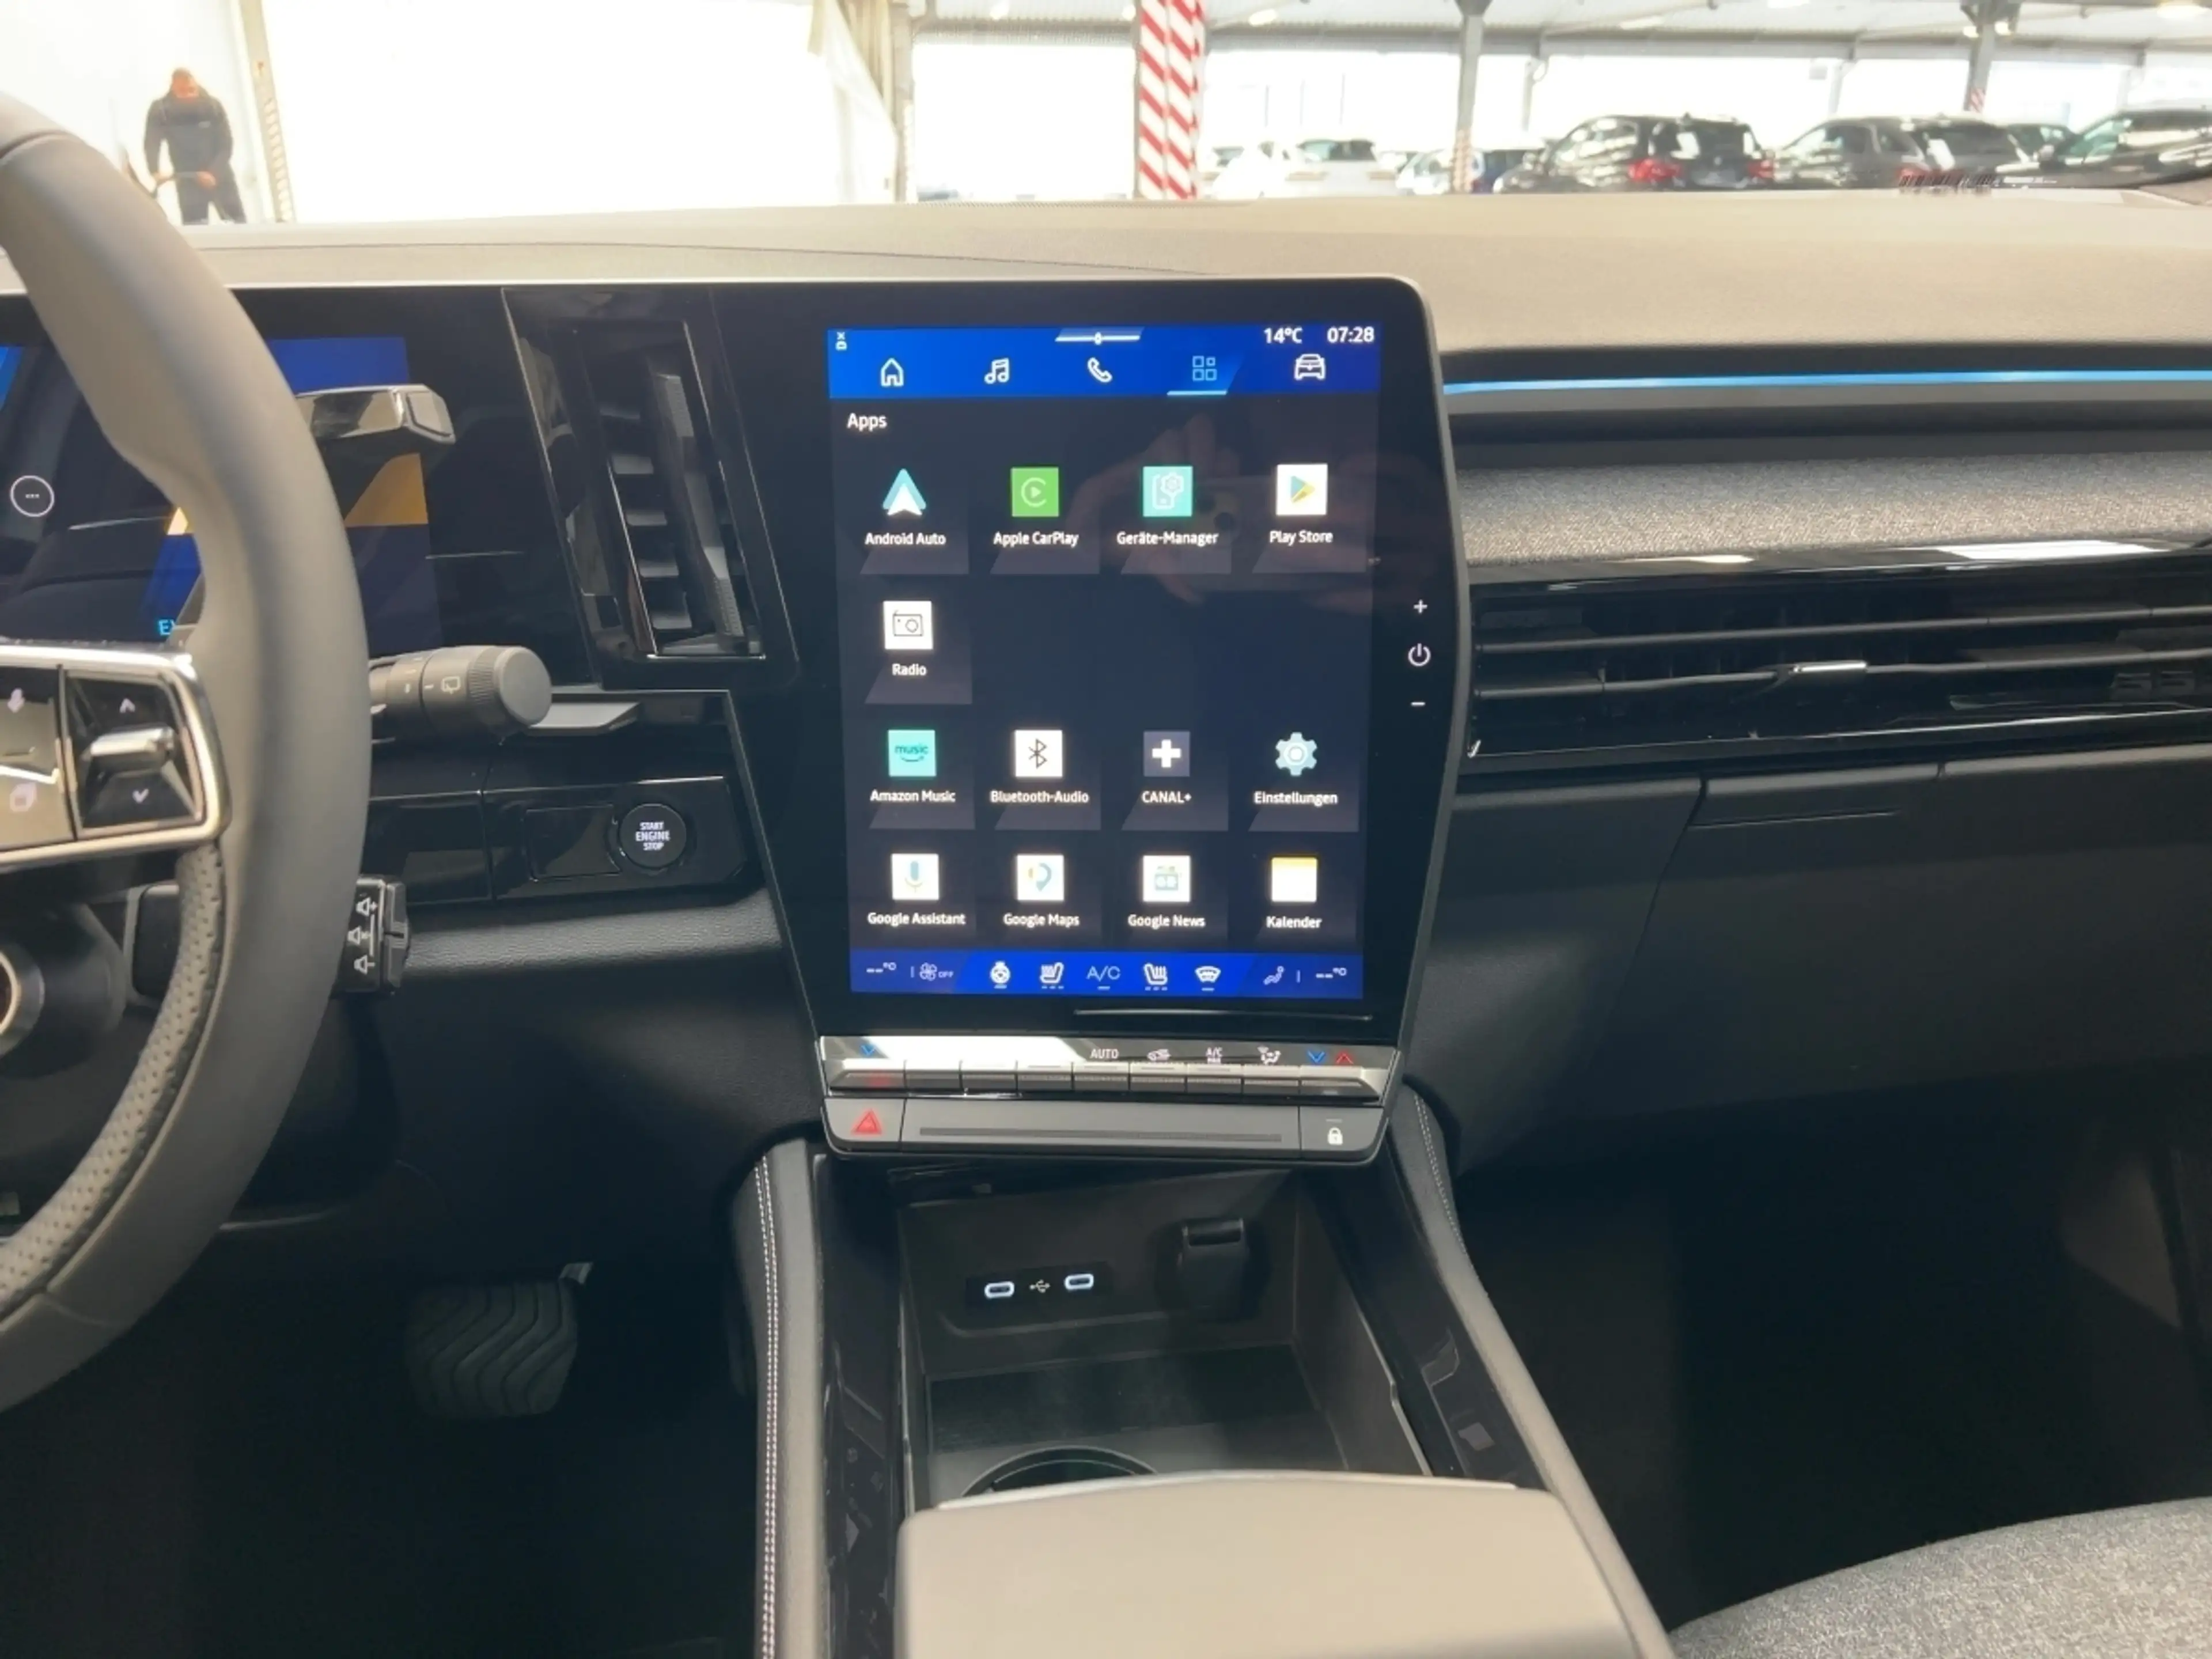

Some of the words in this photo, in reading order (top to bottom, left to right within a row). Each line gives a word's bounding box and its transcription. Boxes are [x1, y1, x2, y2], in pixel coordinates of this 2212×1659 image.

[1327, 326, 1374, 343] 07:28
[847, 412, 887, 431] Apps
[865, 532, 914, 545] Android
[915, 532, 946, 545] Auto
[993, 532, 1030, 548] Apple
[1032, 531, 1079, 548] CarPlay
[1116, 531, 1219, 547] Geräte-Manager
[1270, 530, 1297, 547] Play
[1298, 529, 1334, 543] Store
[892, 663, 927, 676] Radio
[895, 743, 929, 755] music
[870, 789, 919, 802] Amazon
[921, 790, 956, 802] Music
[990, 790, 1089, 803] Bluetooth-Audio
[1141, 790, 1191, 804] CANAL+
[1254, 791, 1338, 807] Einstellungen
[639, 821, 664, 830] START
[635, 831, 670, 842] ENGINE
[643, 842, 664, 850] STOP
[868, 912, 910, 927] Google
[911, 912, 966, 925] Assistant
[1003, 913, 1046, 929] Google
[1048, 914, 1080, 928] Maps
[1128, 914, 1171, 930] Google
[1172, 914, 1206, 927] News
[1266, 916, 1322, 929] Kalender
[1086, 965, 1121, 980] A/C
[1090, 1048, 1119, 1059] AUTO
[1206, 1047, 1223, 1057] A/C
